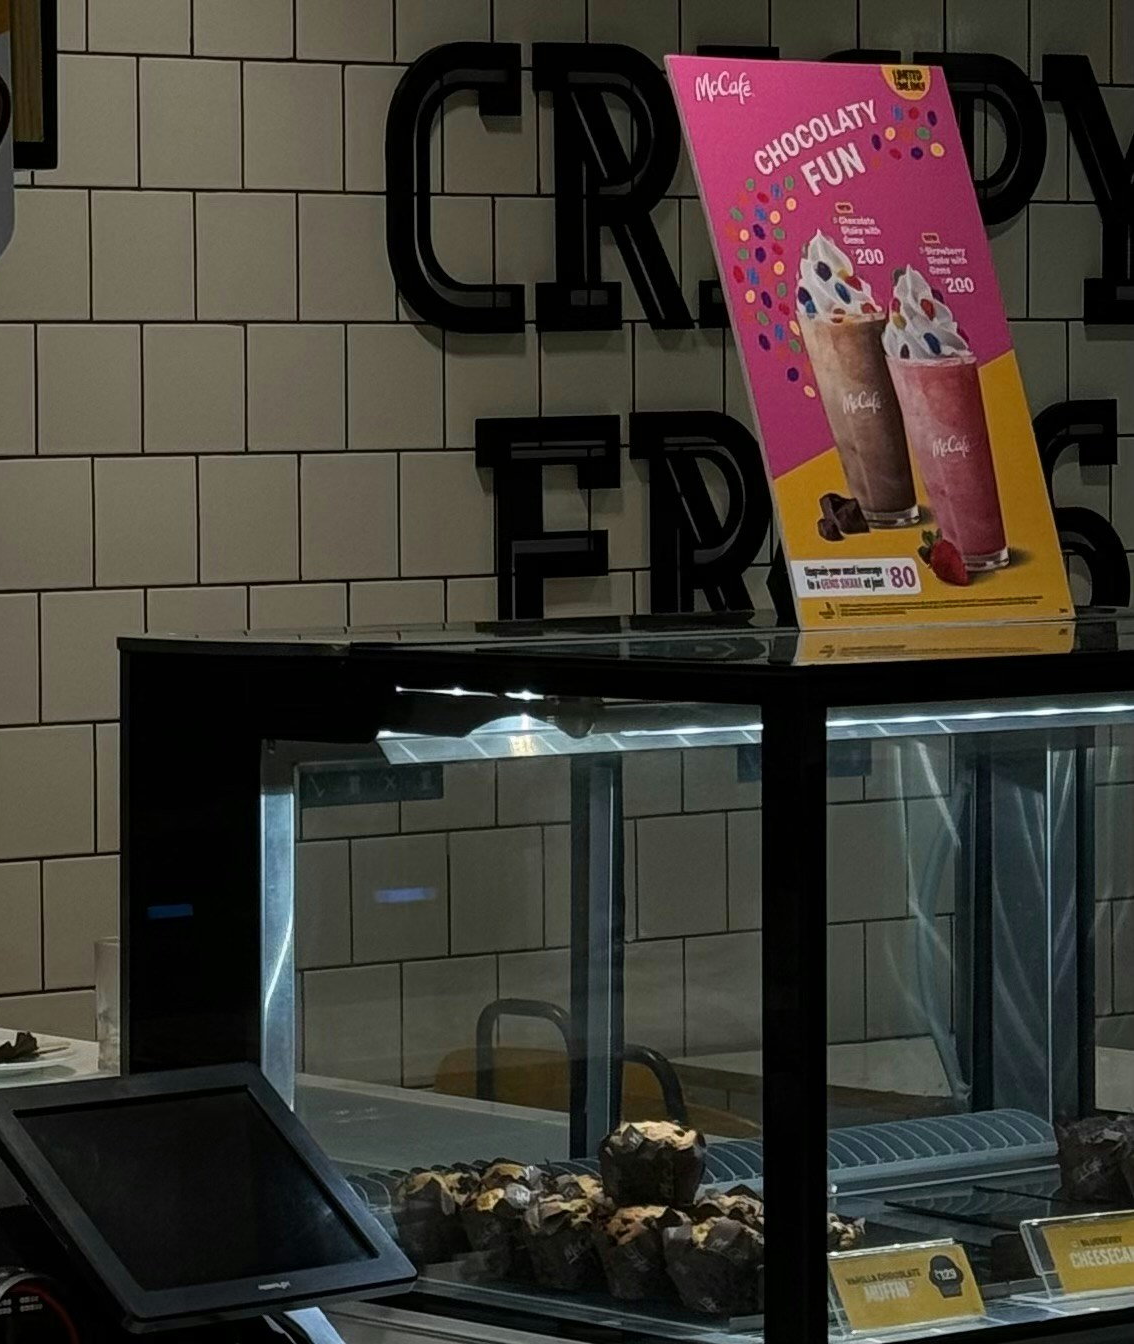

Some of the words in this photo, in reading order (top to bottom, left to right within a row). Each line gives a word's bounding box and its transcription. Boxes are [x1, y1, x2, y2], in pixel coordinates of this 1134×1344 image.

[754, 99, 877, 175] CHOCOLATY
[800, 142, 866, 196] FUN
[385, 42, 1134, 332] CRPY
